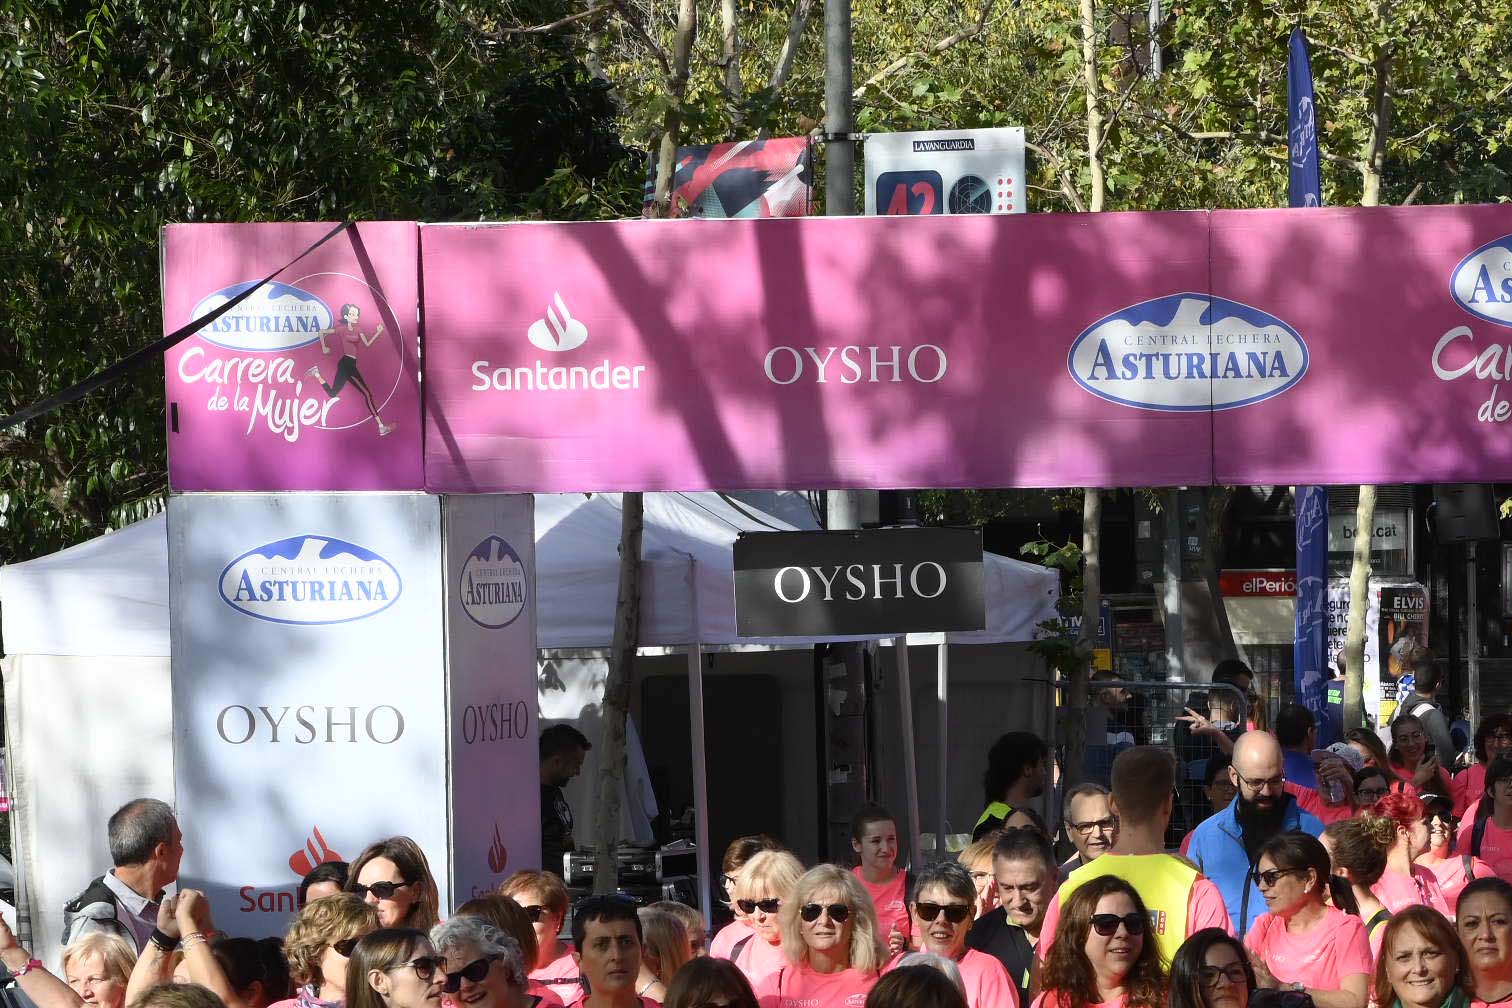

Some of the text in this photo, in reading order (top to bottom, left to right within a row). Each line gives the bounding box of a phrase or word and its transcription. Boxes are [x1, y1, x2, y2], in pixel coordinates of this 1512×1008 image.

[1124, 332, 1281, 346] CENTRAL LECHERA
[178, 347, 295, 384] Carrera
[471, 359, 648, 392] Santander
[764, 344, 948, 385] OYSHO
[1087, 338, 1290, 381] ASTURIANA
[207, 381, 341, 442] de la Mujer
[1477, 384, 1512, 422] de
[234, 568, 389, 602] ASTURIANA
[466, 572, 524, 606] ASTURIANA
[774, 560, 947, 603] OYSHO
[1393, 596, 1424, 609] ELVIS
[216, 704, 405, 744] OYSHO
[463, 700, 529, 744] OYSHO
